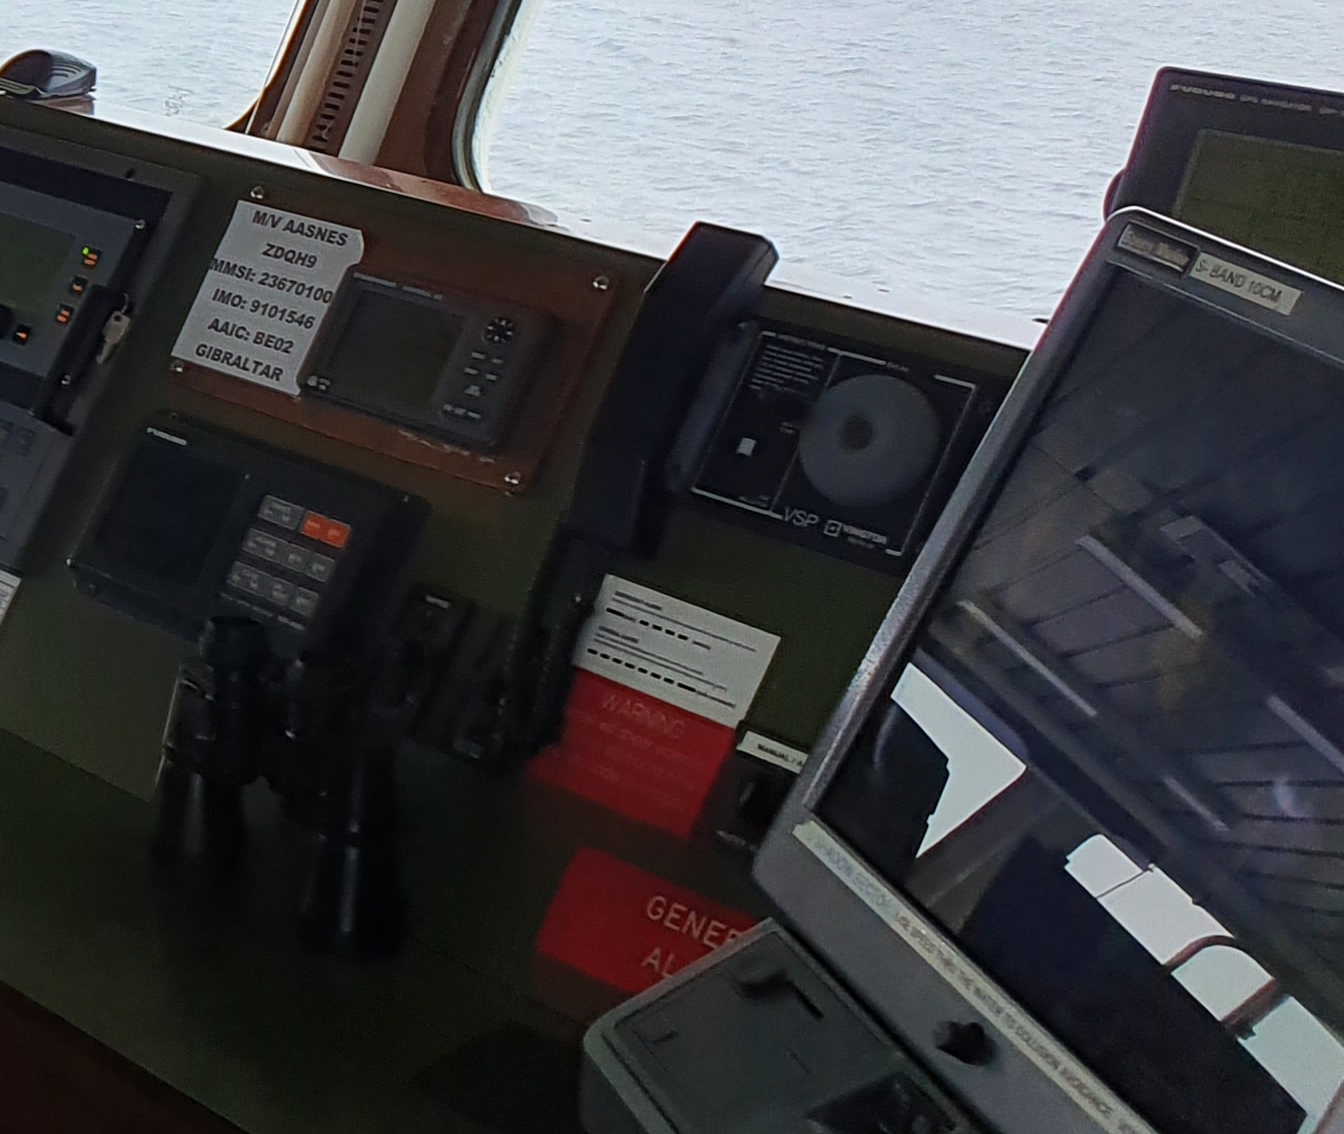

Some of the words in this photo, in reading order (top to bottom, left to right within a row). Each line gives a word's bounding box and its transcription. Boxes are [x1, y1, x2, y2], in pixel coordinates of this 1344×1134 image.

[252, 210, 282, 228] M/V
[282, 220, 349, 247] AASNES
[262, 243, 318, 268] ZDQH9
[211, 258, 257, 283] MMSI:
[258, 272, 334, 304] 23670100
[1209, 265, 1246, 289] BAND
[1248, 280, 1283, 303] 10CM
[212, 288, 248, 310] IMO:
[249, 300, 316, 329] 9101546
[208, 318, 251, 341] AAIC:
[253, 331, 294, 354] BE02
[195, 343, 284, 382] GIBRALTAR
[784, 507, 820, 527] VSP
